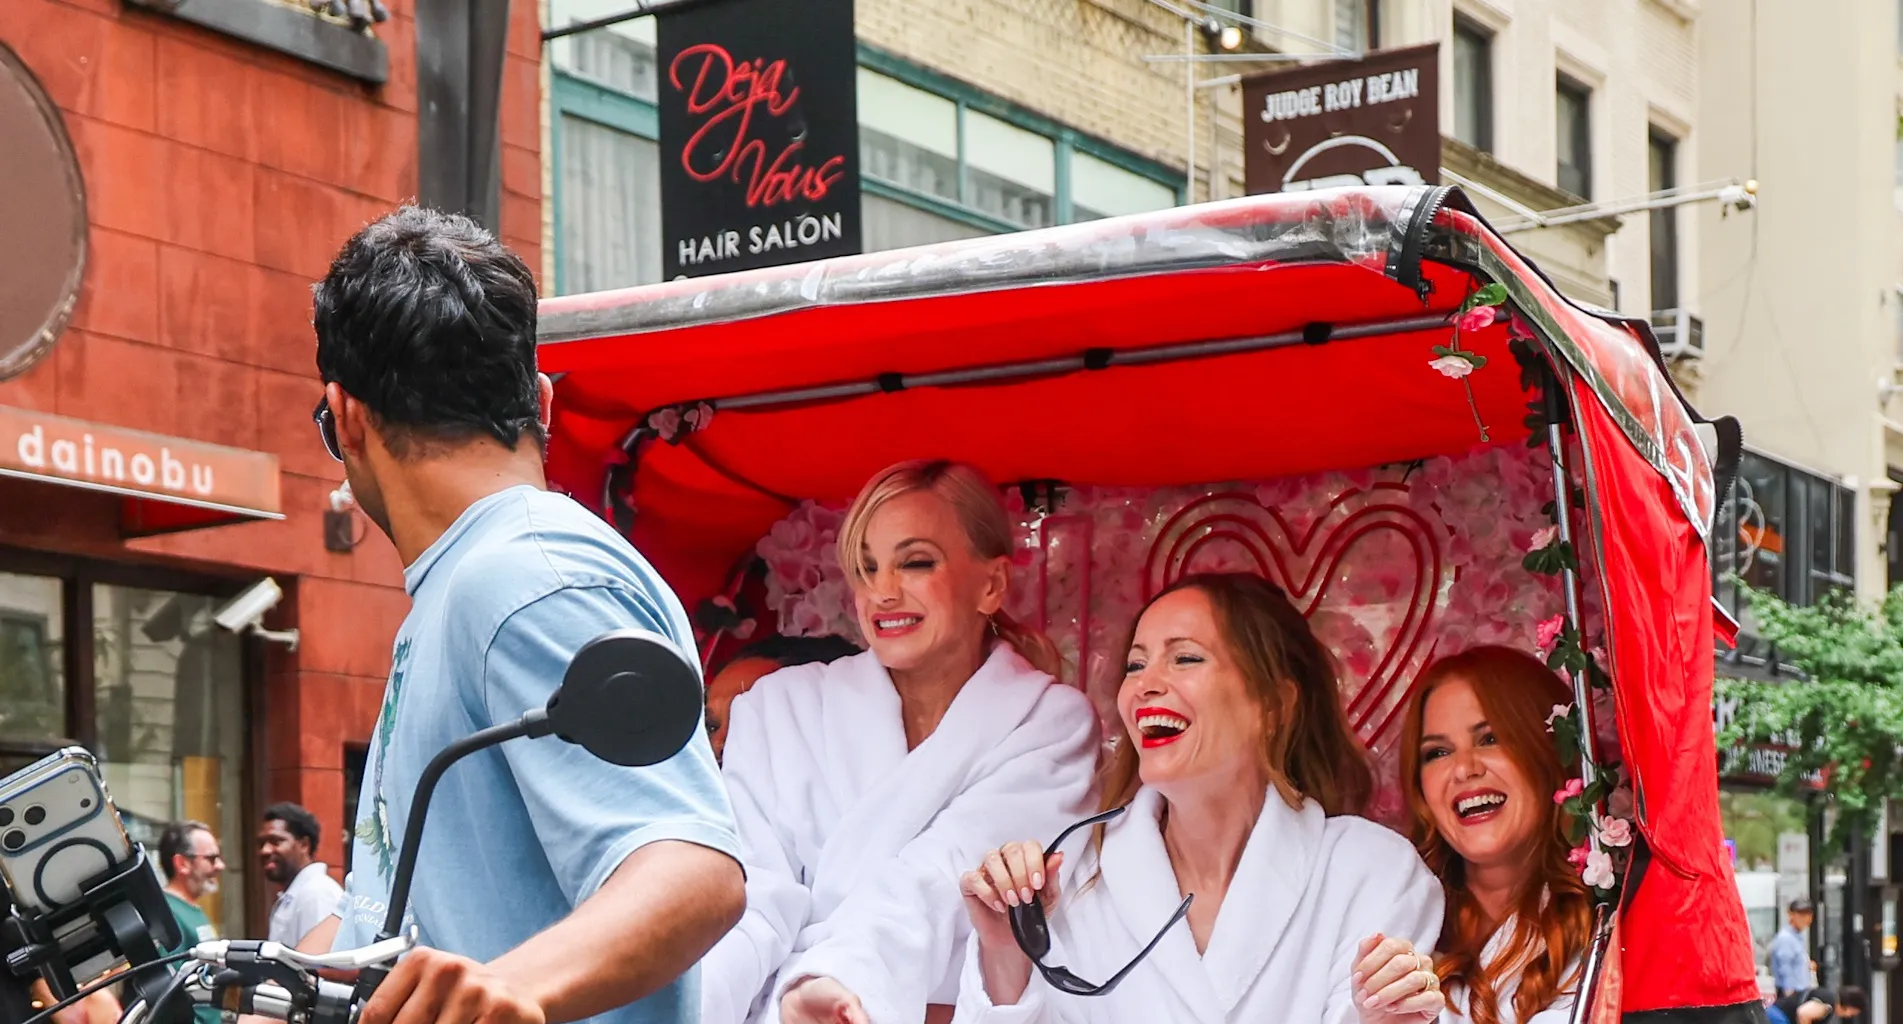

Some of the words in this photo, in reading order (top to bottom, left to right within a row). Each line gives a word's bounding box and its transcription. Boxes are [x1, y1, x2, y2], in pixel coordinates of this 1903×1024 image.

[669, 43, 801, 182] Deja
[1260, 86, 1322, 123] JUDGE
[1324, 78, 1364, 113] ROY
[1366, 68, 1419, 105] BEAN
[731, 139, 846, 208] Vous
[678, 231, 741, 267] HAIR
[748, 211, 843, 255] SALON
[17, 424, 214, 495] dainobu
